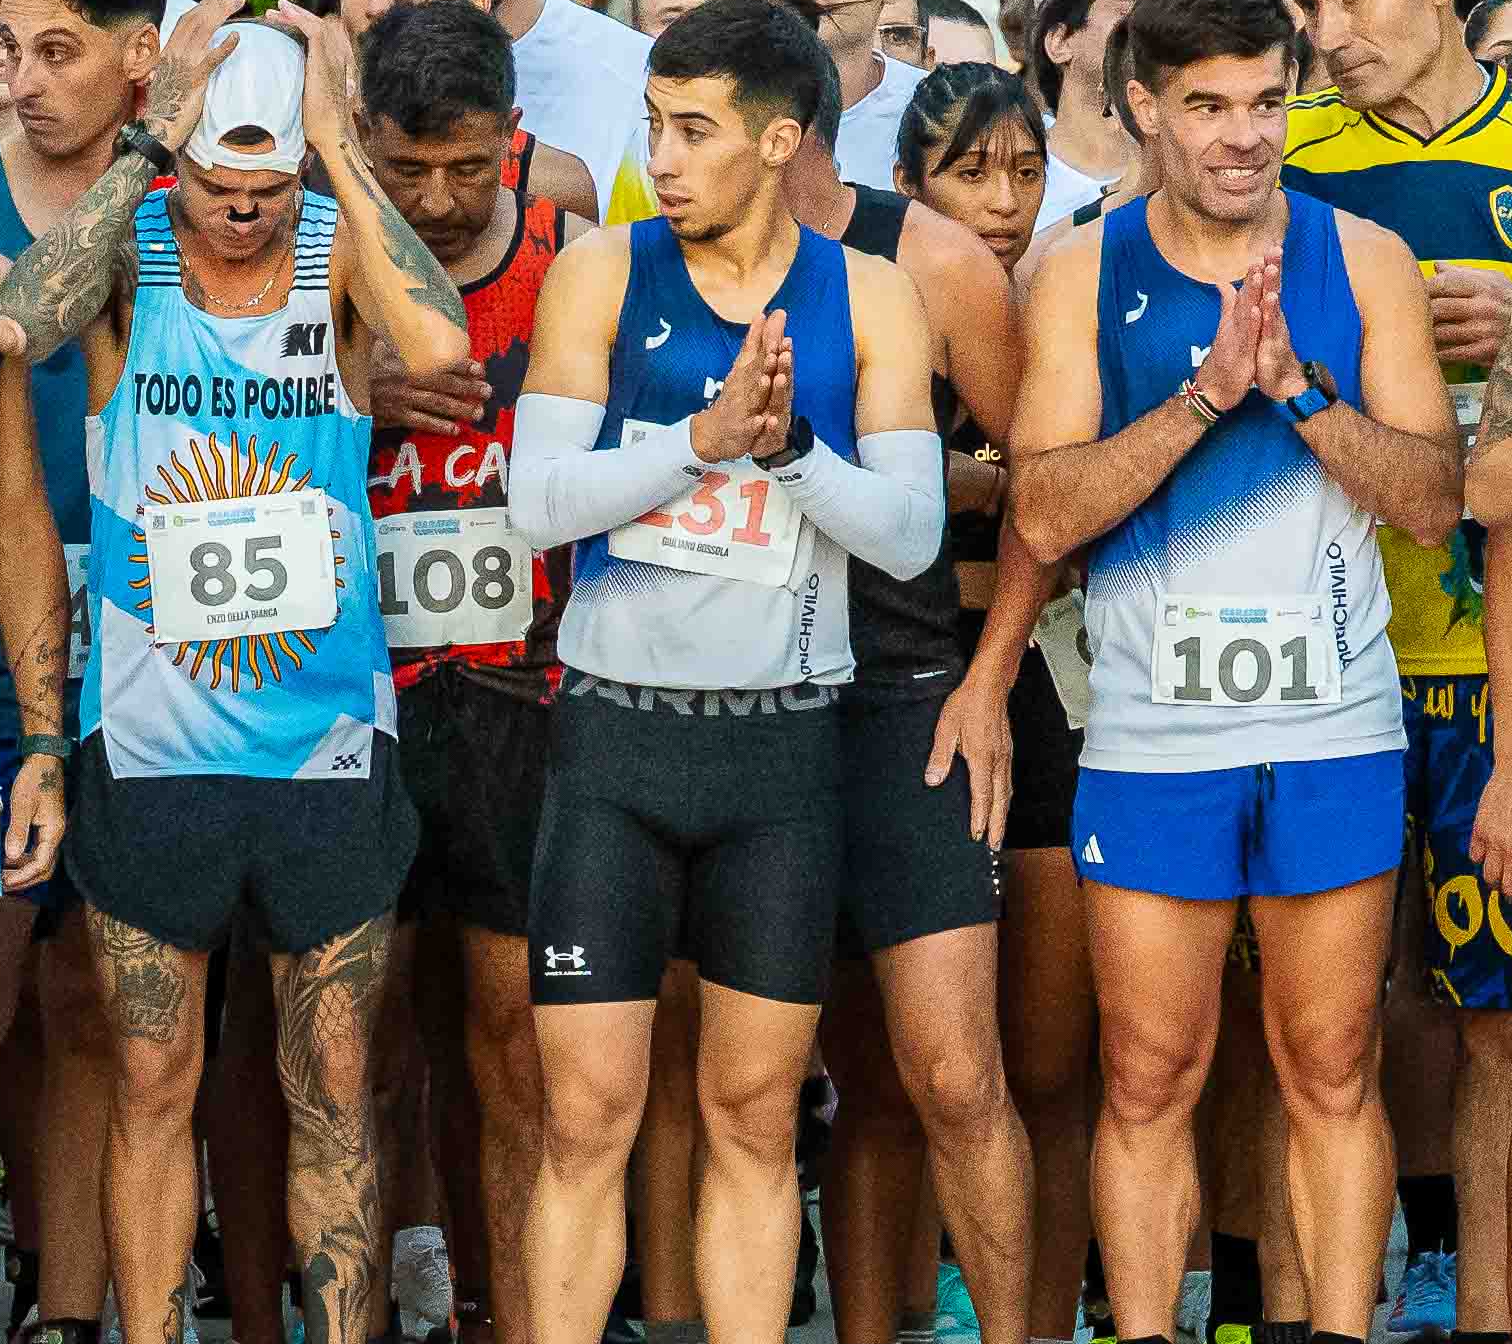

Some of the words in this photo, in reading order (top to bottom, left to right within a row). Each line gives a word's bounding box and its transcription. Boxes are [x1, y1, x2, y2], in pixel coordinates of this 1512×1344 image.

[134, 372, 201, 417] TODO
[212, 375, 236, 417] ES
[244, 372, 336, 419] POSIBLE
[636, 470, 772, 547] 31
[189, 536, 288, 606] 85
[376, 546, 516, 616] 108
[1174, 636, 1319, 703] 101
